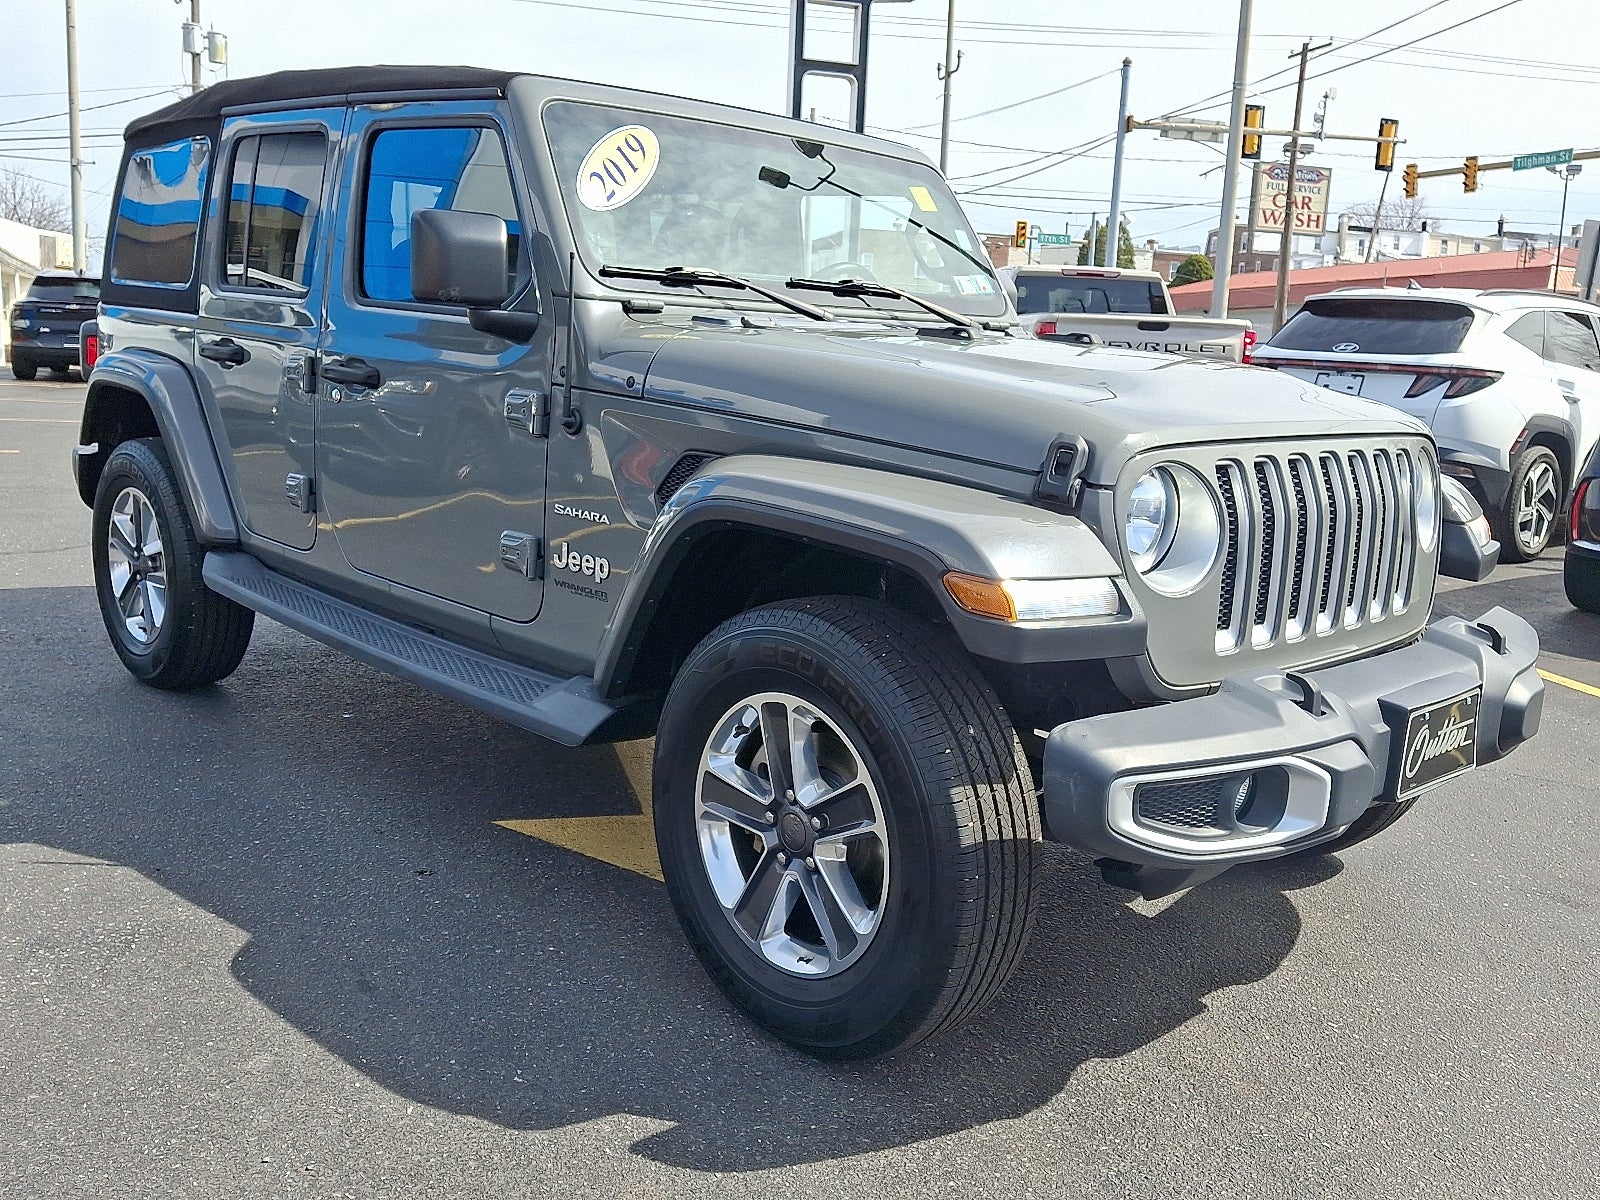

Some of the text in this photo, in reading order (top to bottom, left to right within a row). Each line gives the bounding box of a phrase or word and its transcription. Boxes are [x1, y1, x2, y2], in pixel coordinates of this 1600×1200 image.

[590, 133, 645, 202] 2019
[1516, 152, 1570, 169] Tilghman St
[1267, 182, 1322, 195] FULL ERVICE
[1041, 235, 1068, 244] 17th St
[554, 503, 611, 525] SAHARA
[553, 542, 611, 584] Jeep
[554, 579, 609, 599] WRANGLER
[1405, 716, 1475, 778] Outten
